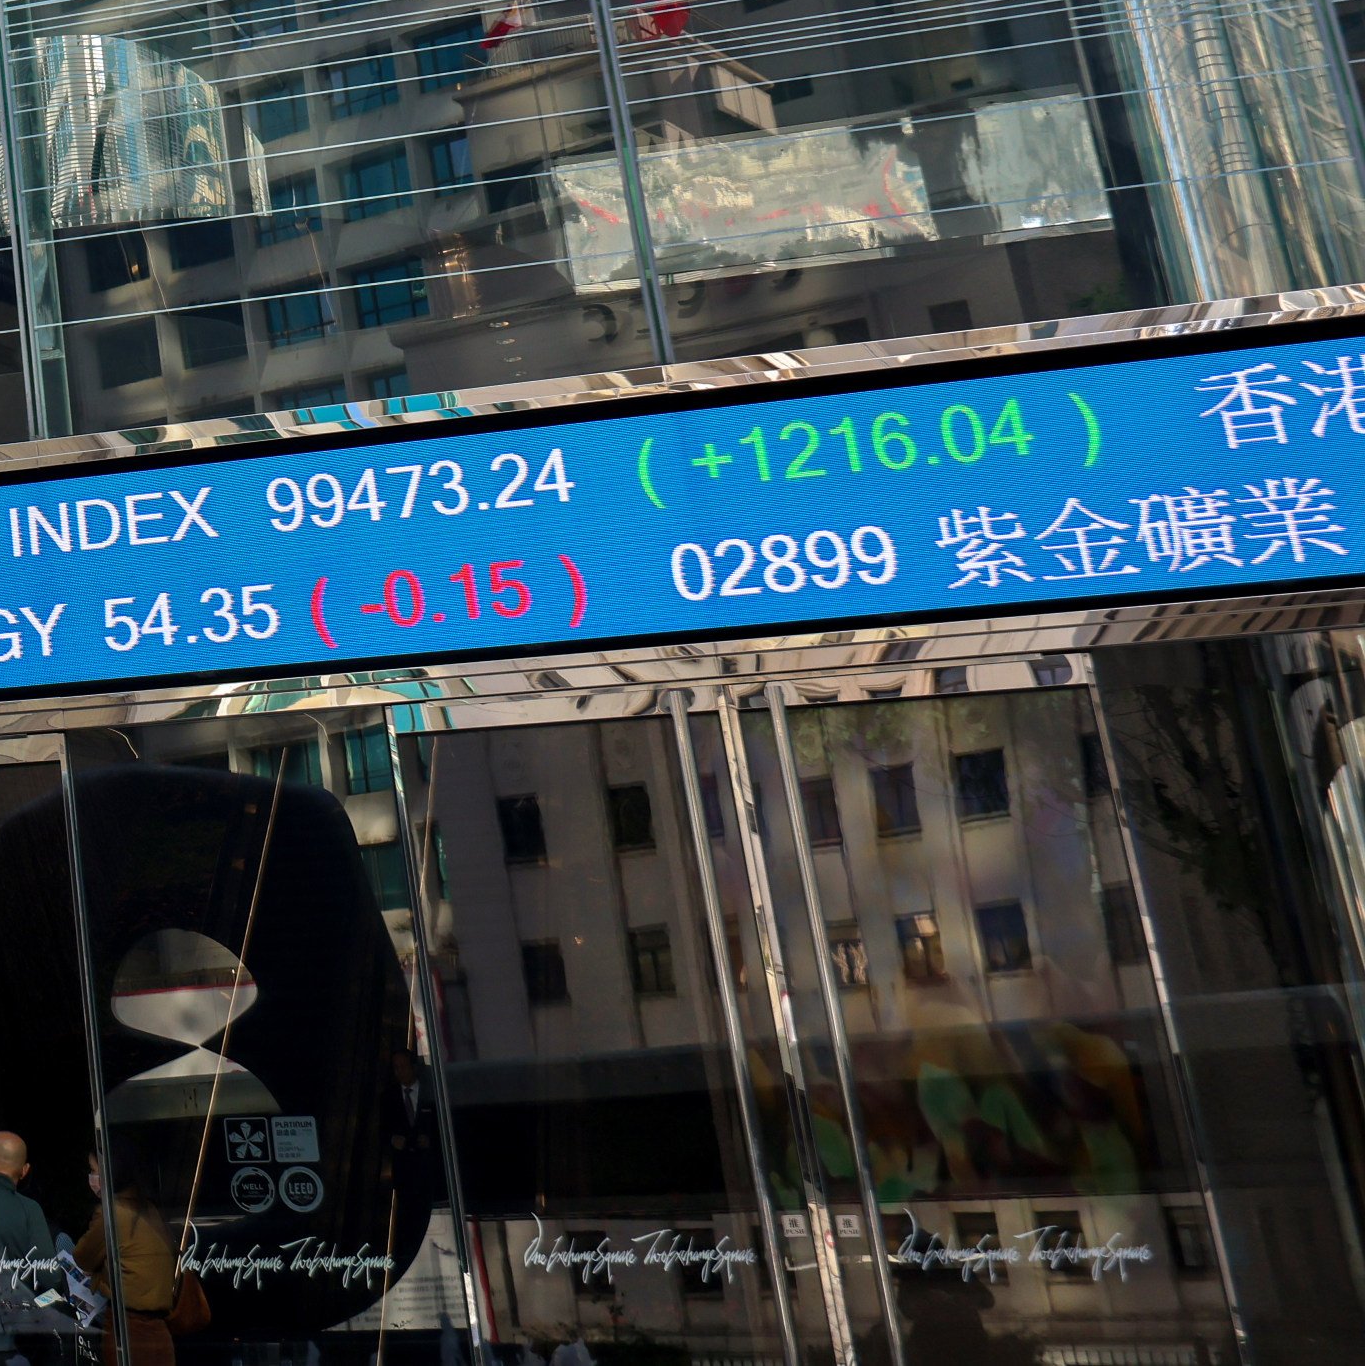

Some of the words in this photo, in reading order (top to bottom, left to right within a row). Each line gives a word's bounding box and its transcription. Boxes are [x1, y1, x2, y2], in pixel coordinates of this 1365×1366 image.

[9, 487, 219, 557] INDEX
[266, 448, 575, 532] 99473.24
[104, 584, 280, 651] 54.35
[671, 525, 898, 601] 02899
[935, 477, 1350, 589] 紫金礦業
[288, 1182, 314, 1194] LEED
